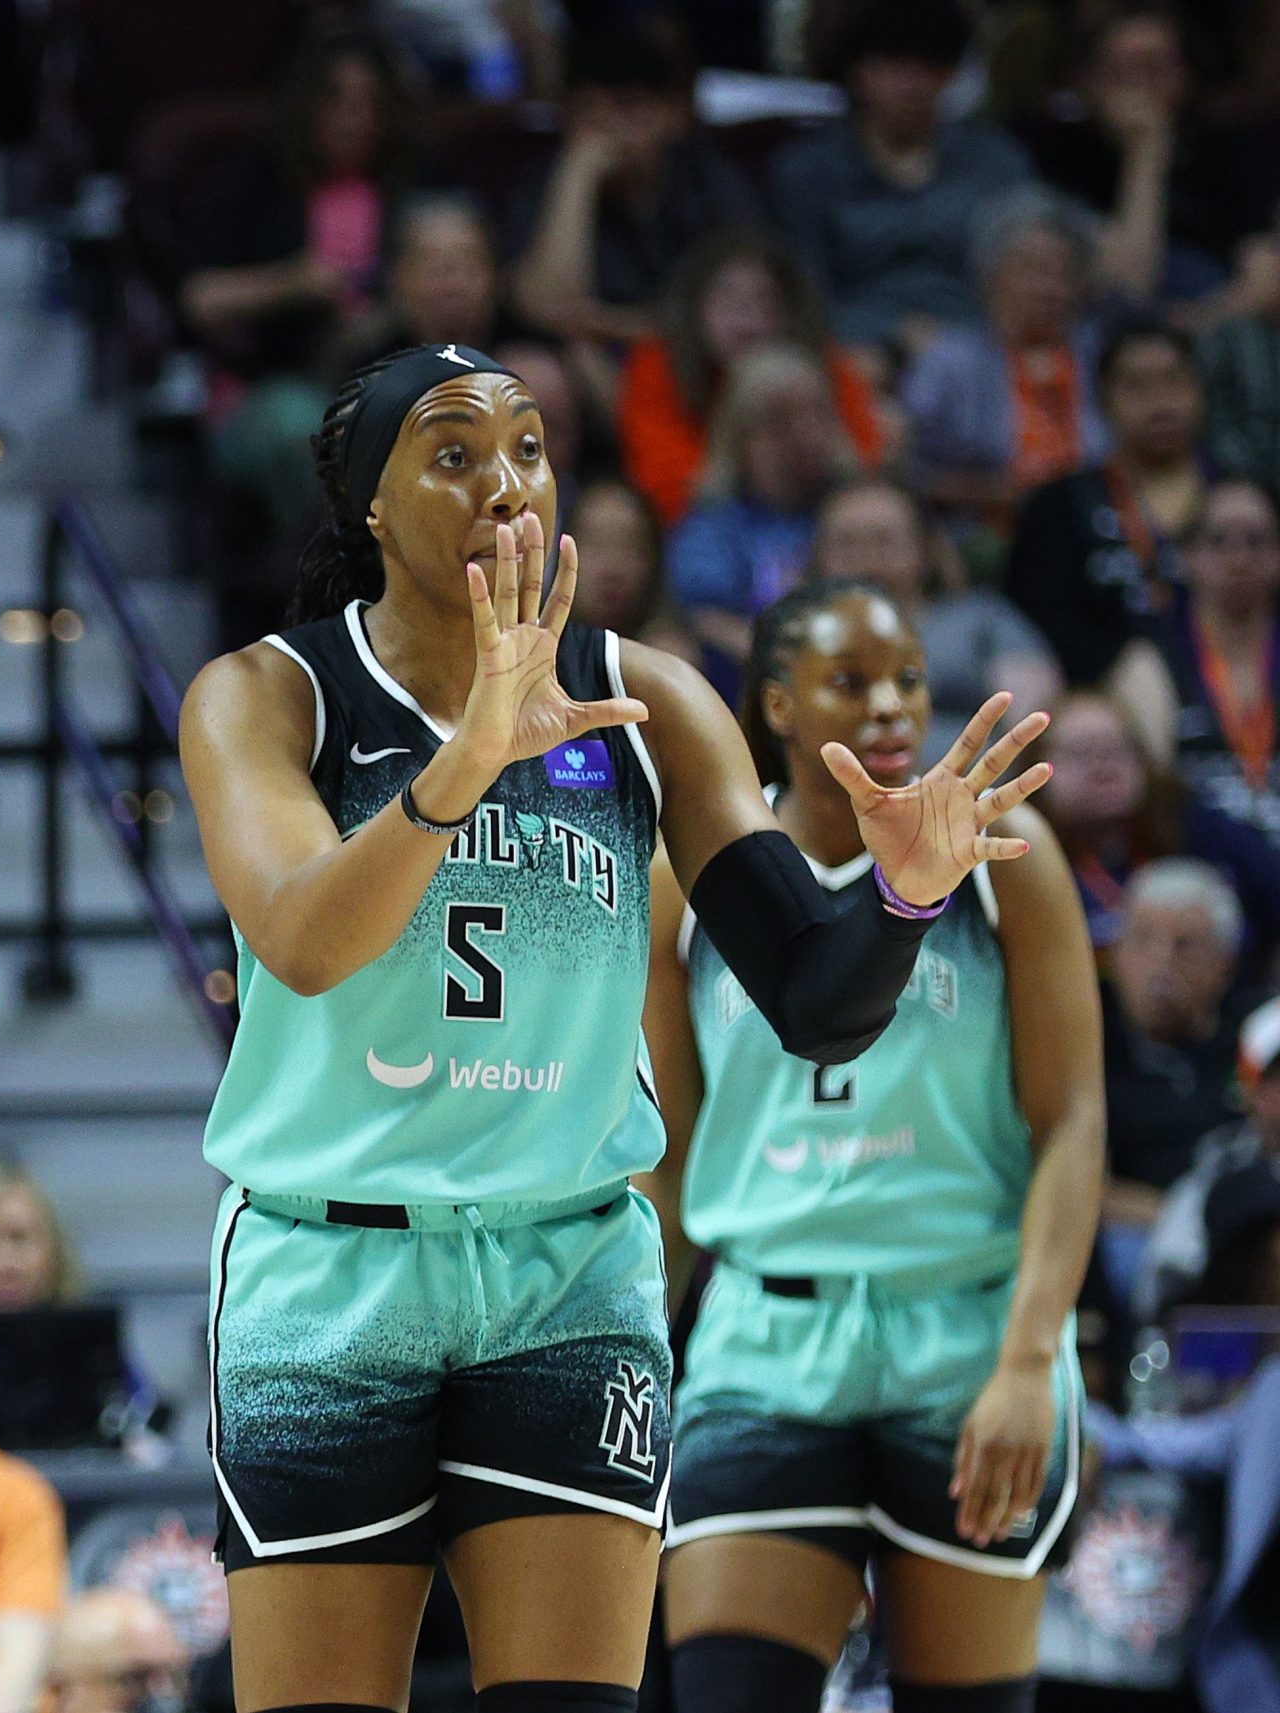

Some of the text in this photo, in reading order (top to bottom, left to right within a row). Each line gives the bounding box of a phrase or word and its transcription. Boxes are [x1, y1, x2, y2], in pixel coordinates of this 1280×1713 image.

[555, 769, 607, 783] BARCLAYS
[442, 902, 506, 1022] 5
[448, 1057, 565, 1093] Webull
